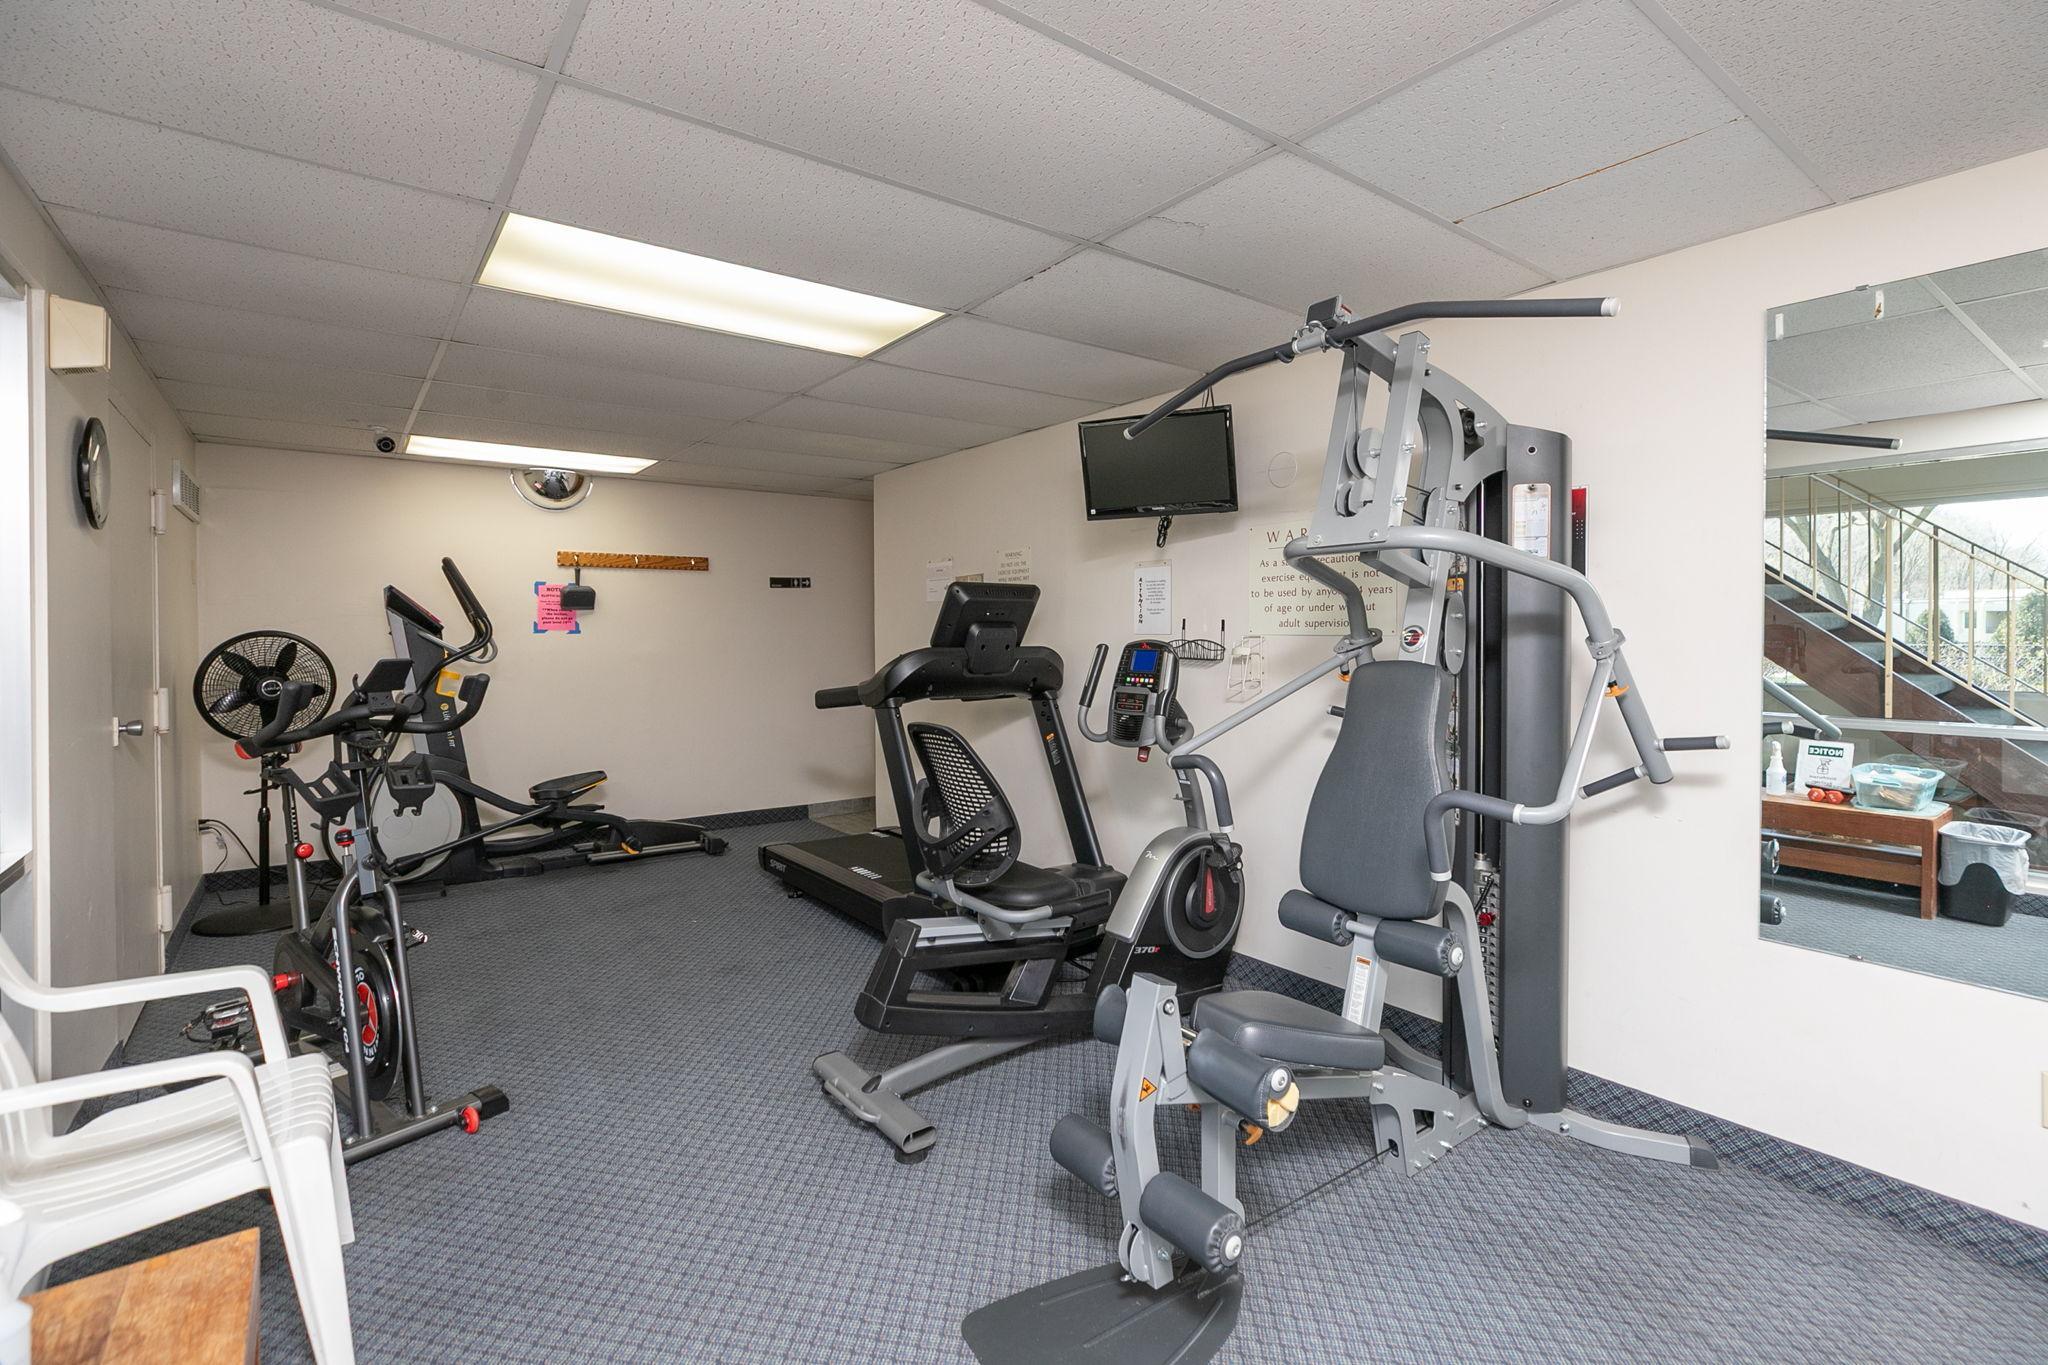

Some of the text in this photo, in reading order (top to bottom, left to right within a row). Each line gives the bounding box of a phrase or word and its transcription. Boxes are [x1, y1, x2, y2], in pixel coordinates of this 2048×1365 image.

[1316, 554, 1360, 564] recaution
[1261, 574, 1295, 582] exercise
[1352, 570, 1359, 578] is
[1363, 569, 1380, 577] not
[1251, 590, 1260, 598] to
[1263, 589, 1274, 597] be
[1277, 588, 1297, 597] used
[1301, 587, 1313, 601] by
[1316, 588, 1339, 601] anyo
[1368, 586, 1394, 595] years
[1264, 603, 1273, 612] of
[1276, 606, 1292, 615] age
[1308, 603, 1334, 612] under
[1279, 618, 1350, 631] adult supervisio
[1133, 946, 1161, 955] 370r
